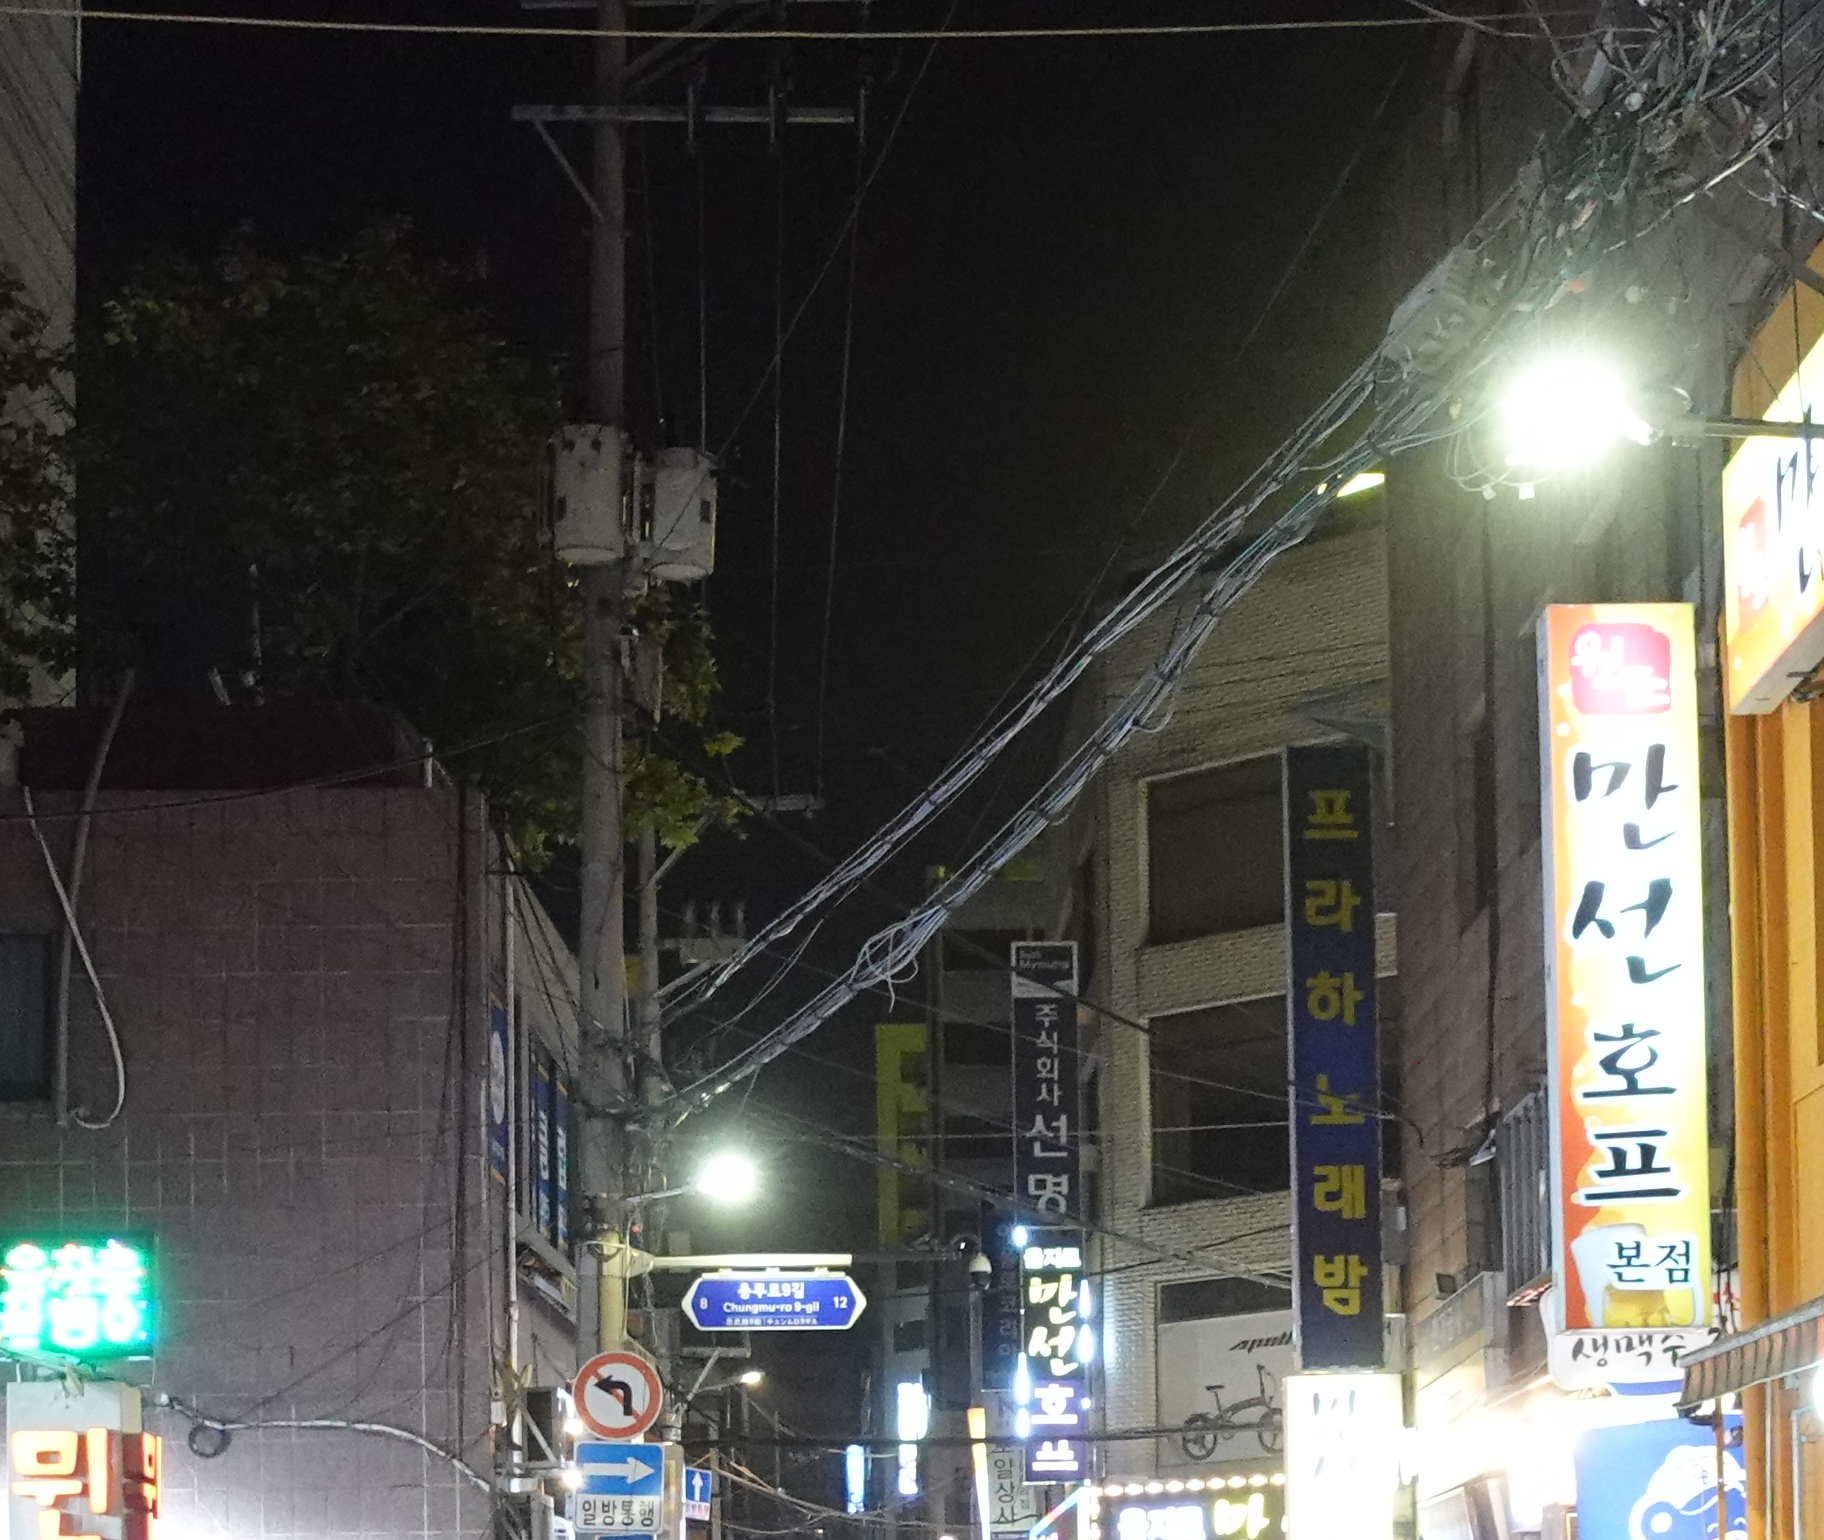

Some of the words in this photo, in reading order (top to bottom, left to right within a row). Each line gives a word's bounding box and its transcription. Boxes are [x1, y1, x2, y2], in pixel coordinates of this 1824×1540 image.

[1572, 742, 1683, 1200] 만선호프
[1034, 1003, 1063, 1107] 주식회사
[1026, 1113, 1070, 1216] 선명
[1606, 1240, 1692, 1284] 본점
[699, 1297, 709, 1310] 8
[722, 1302, 793, 1315] Chungmu-ro
[794, 1302, 820, 1315] 9-gil
[832, 1296, 849, 1309] 12
[581, 1499, 655, 1528] 일방통행
